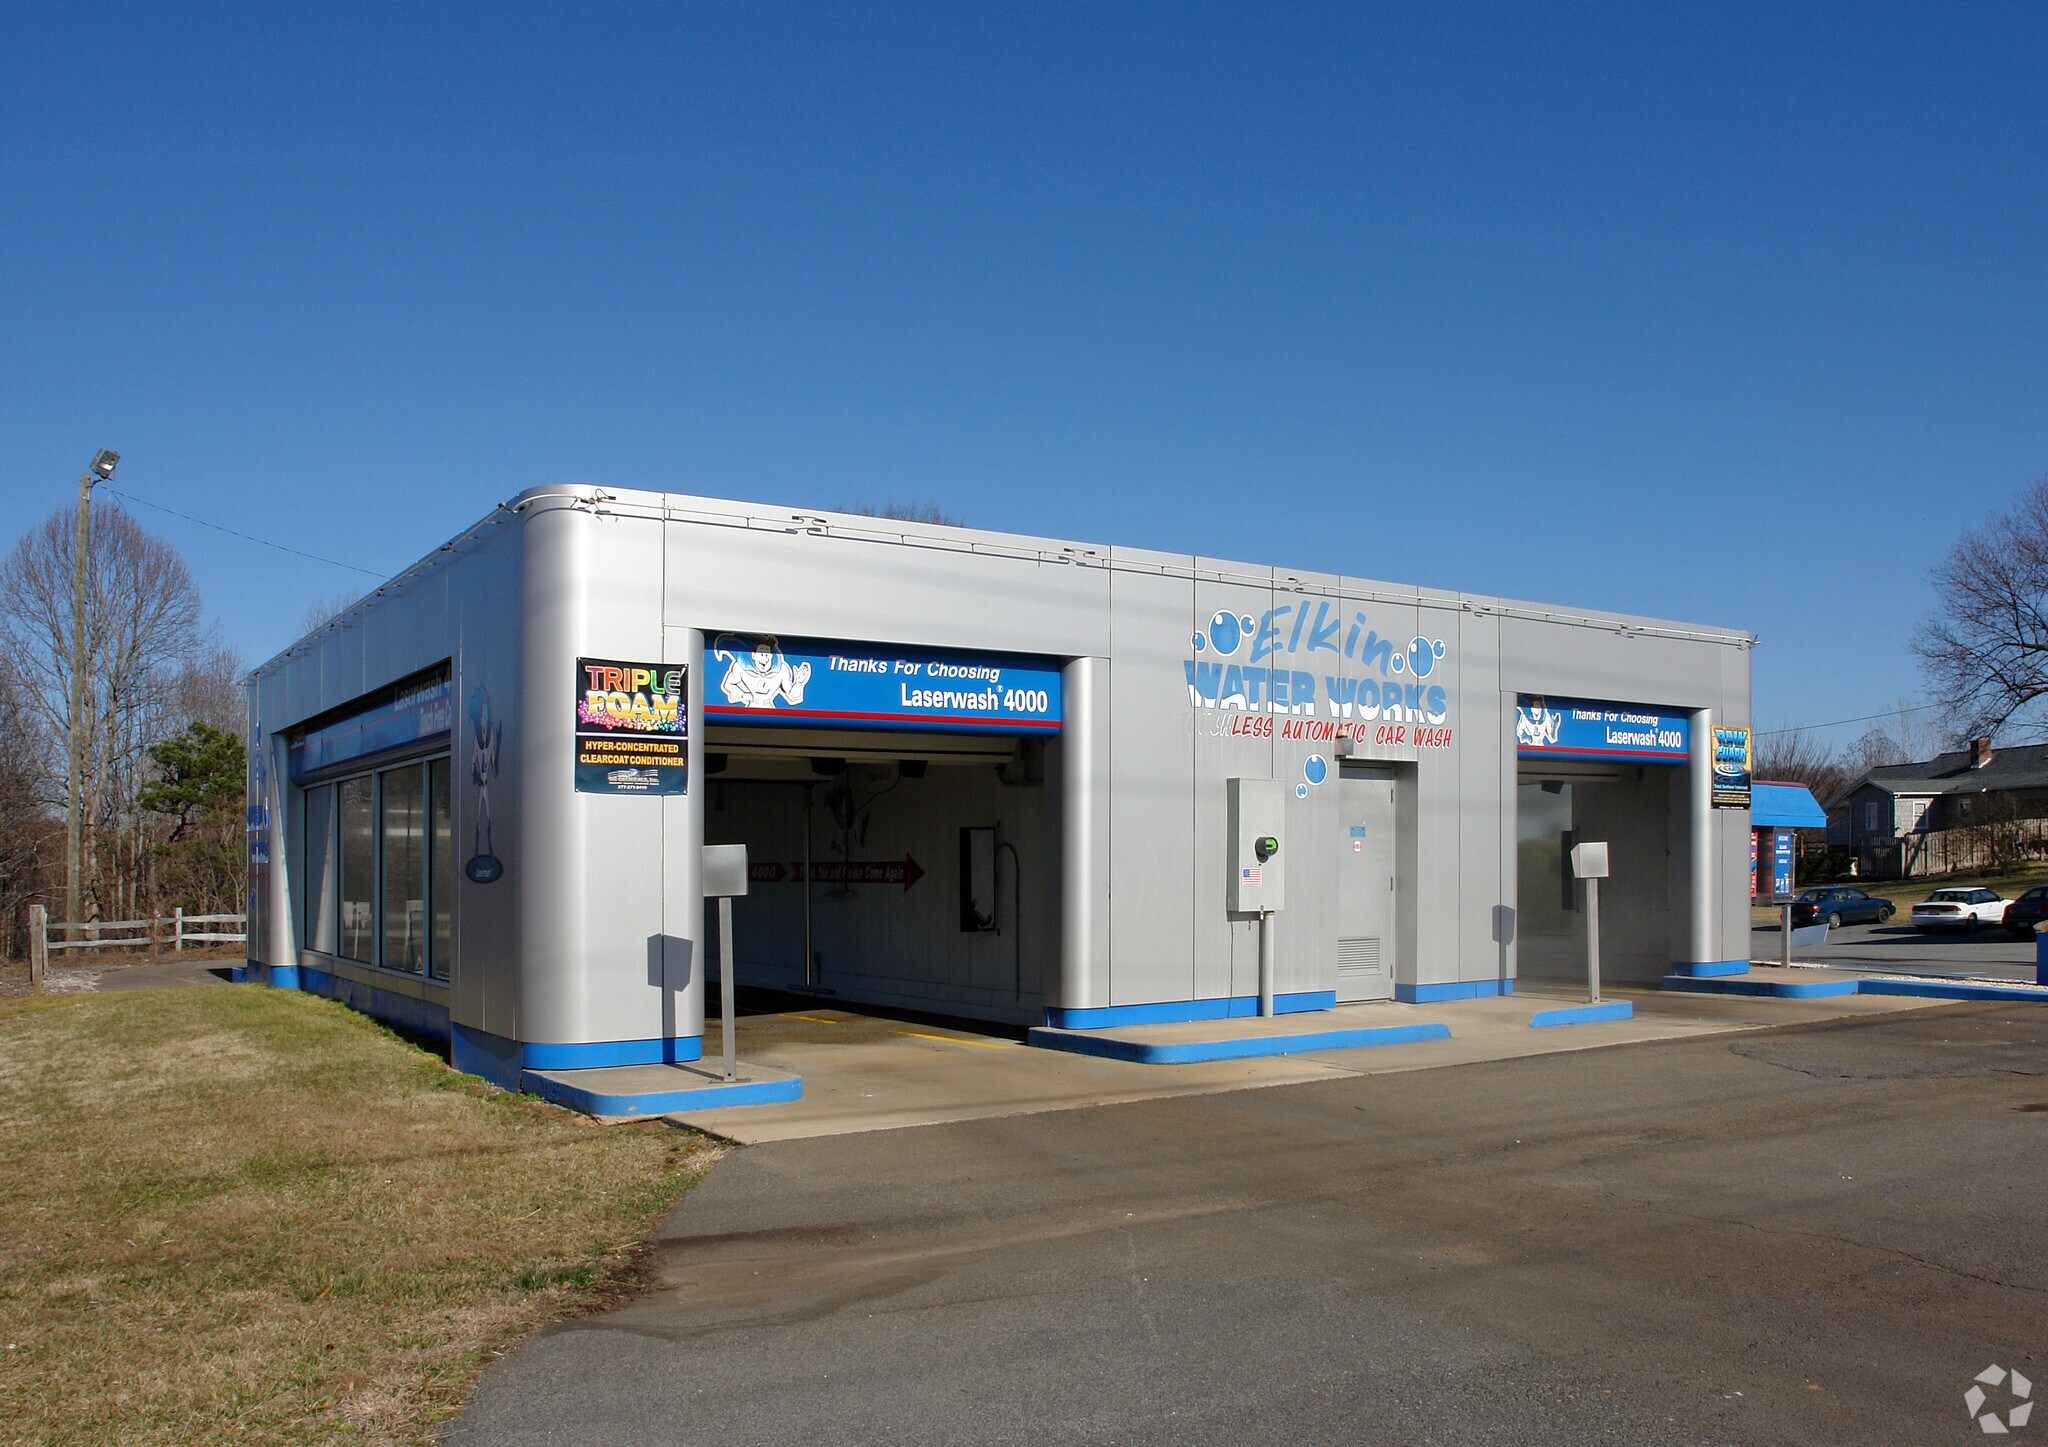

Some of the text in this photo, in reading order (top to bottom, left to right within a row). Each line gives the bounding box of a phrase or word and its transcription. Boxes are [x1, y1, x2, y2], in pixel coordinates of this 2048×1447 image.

[1250, 600, 1393, 677] Elkin
[828, 655, 1000, 683] Thanks For Choosing
[585, 666, 681, 695] TRIPLE
[1003, 689, 1048, 713] 4000
[1183, 660, 1447, 725] WATER WORKS
[586, 691, 680, 721] FOAM
[1571, 708, 1658, 727] Thanks For Choosing
[1375, 725, 1406, 747] CAR
[1412, 726, 1453, 748] WASH
[1658, 730, 1682, 748] 4000
[1715, 729, 1748, 746] RAIN
[585, 741, 679, 753] HYPER-CONCENTRATED
[1715, 746, 1747, 763] GUARD
[580, 754, 684, 766] CLEARCOAT CONDITIONER
[751, 866, 776, 879] 4000
[864, 866, 882, 880] Come
[884, 866, 904, 881] Again
